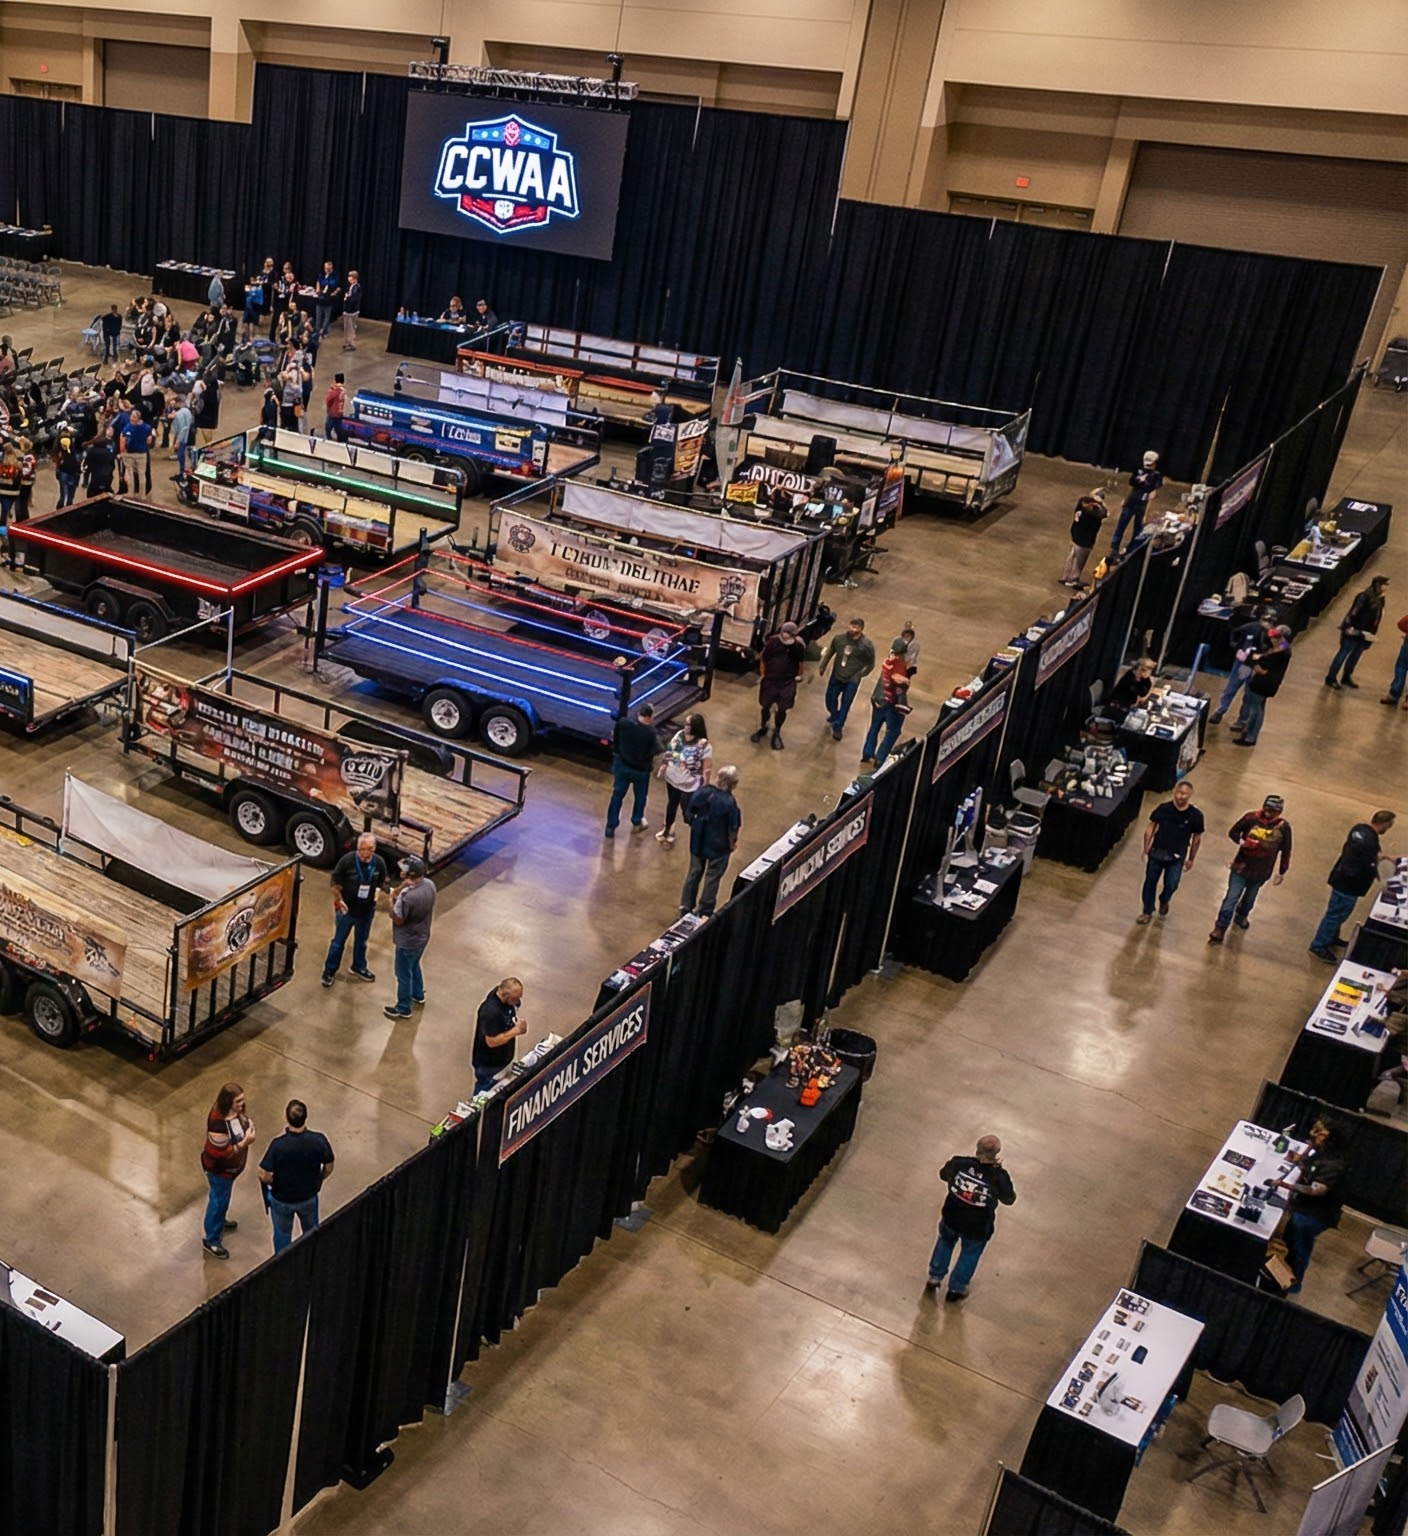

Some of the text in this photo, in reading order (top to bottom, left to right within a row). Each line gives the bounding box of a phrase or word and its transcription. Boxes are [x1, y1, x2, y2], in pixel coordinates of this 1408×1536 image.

[442, 145, 572, 208] CCWAA
[507, 1004, 644, 1140] FINANCIAL SERVICES
